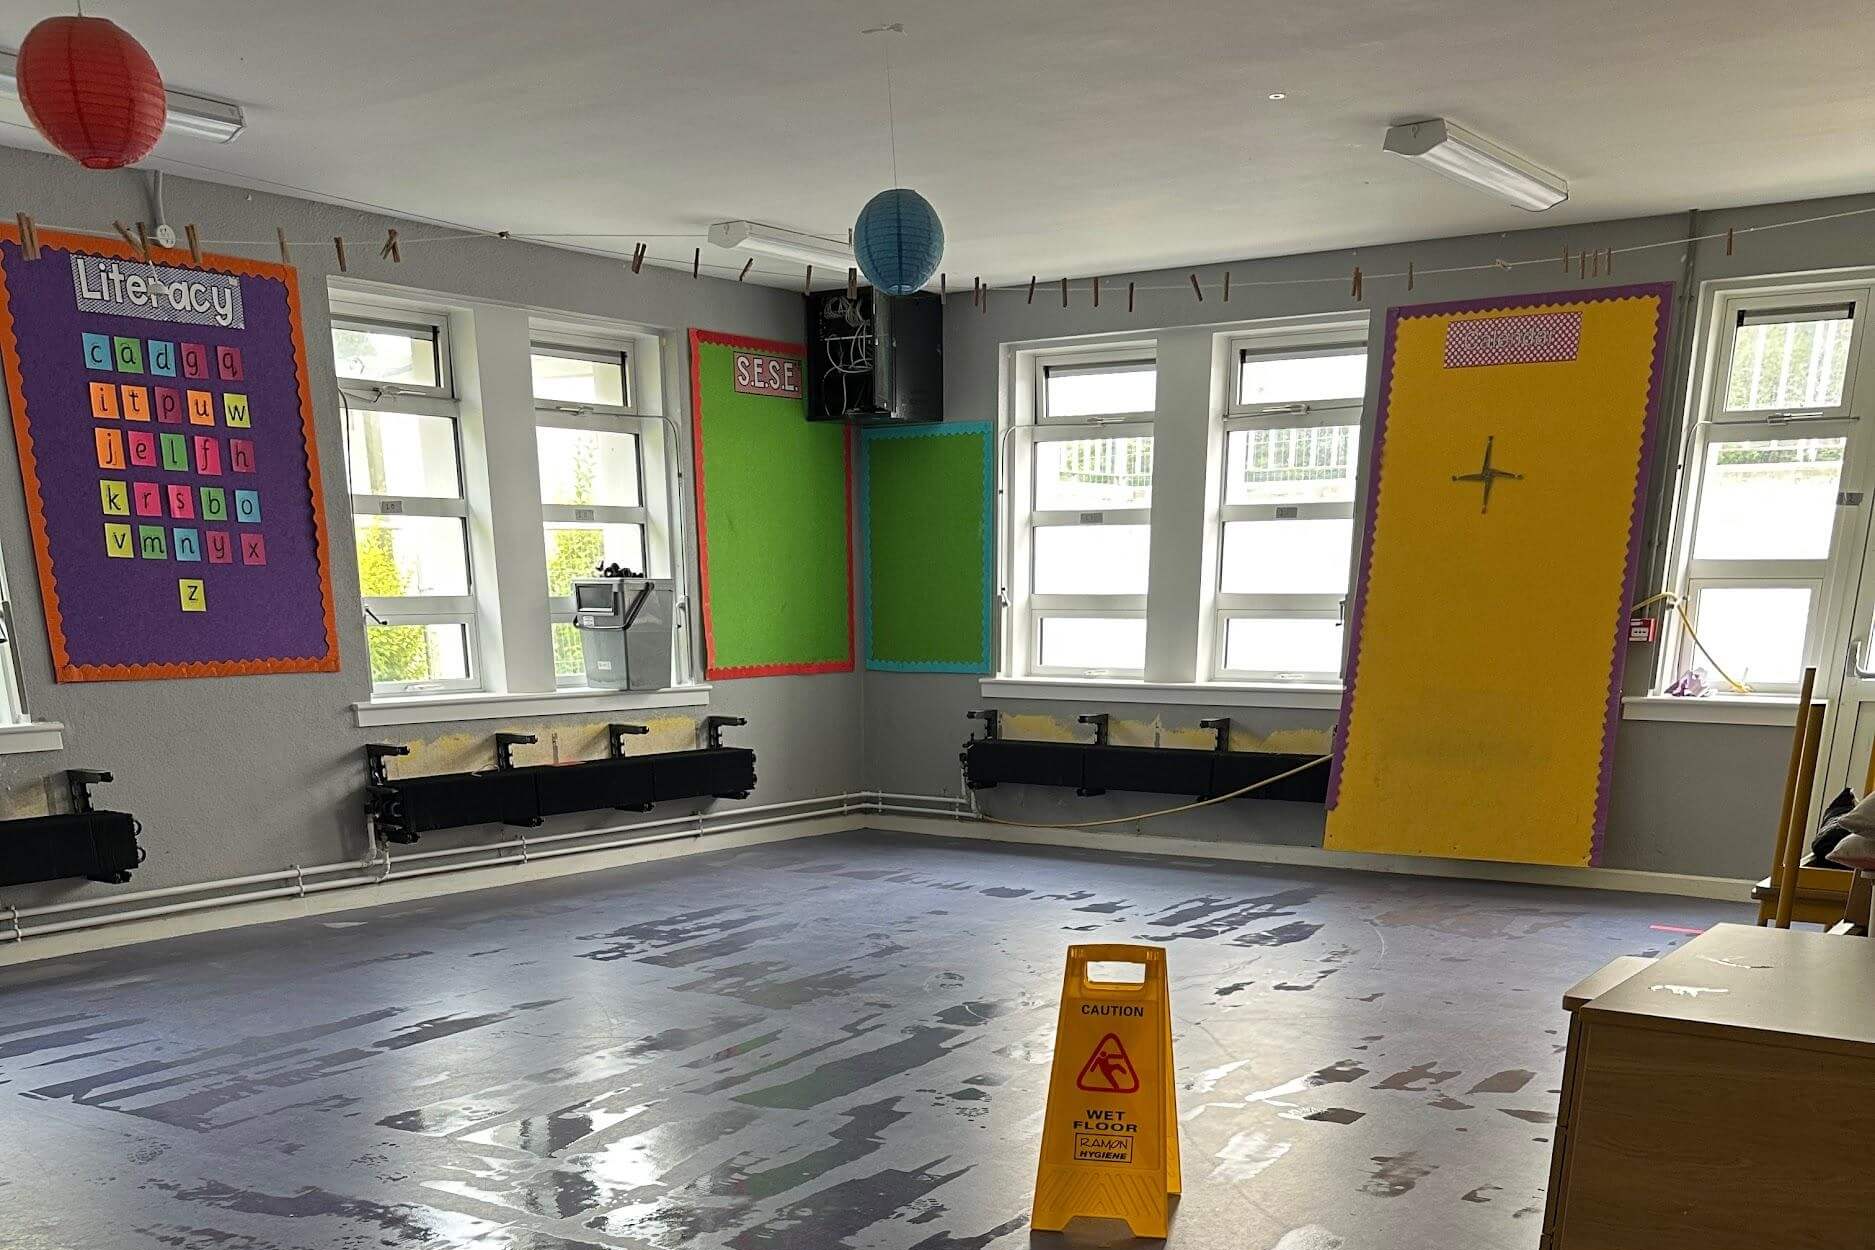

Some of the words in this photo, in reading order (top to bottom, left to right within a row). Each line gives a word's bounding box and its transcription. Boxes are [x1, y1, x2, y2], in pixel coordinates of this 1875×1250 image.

[76, 257, 235, 327] Literacy
[90, 344, 102, 363] c
[121, 345, 136, 365] a
[156, 344, 171, 370] d
[186, 350, 199, 376] g
[222, 352, 238, 377] q
[737, 355, 800, 392] S.E.S.E.
[129, 389, 140, 412] t
[162, 394, 175, 419] p
[195, 399, 209, 417] u
[228, 404, 246, 422] w
[135, 442, 147, 459] e
[235, 445, 249, 467] h
[107, 485, 121, 511] k
[143, 492, 152, 509] r
[176, 492, 185, 510] s
[208, 490, 221, 515] b
[241, 499, 253, 515] o
[113, 532, 126, 549] v
[143, 536, 165, 554] m
[181, 537, 195, 554] n
[213, 535, 225, 559] y
[249, 542, 260, 558] x
[187, 585, 199, 601] z
[1081, 1004, 1144, 1017] CAUTION
[1073, 1120, 1138, 1132] FLOOR
[1086, 1110, 1126, 1121] WET
[1079, 1150, 1129, 1160] HYGIENE
[1080, 1138, 1129, 1150] RAMON
